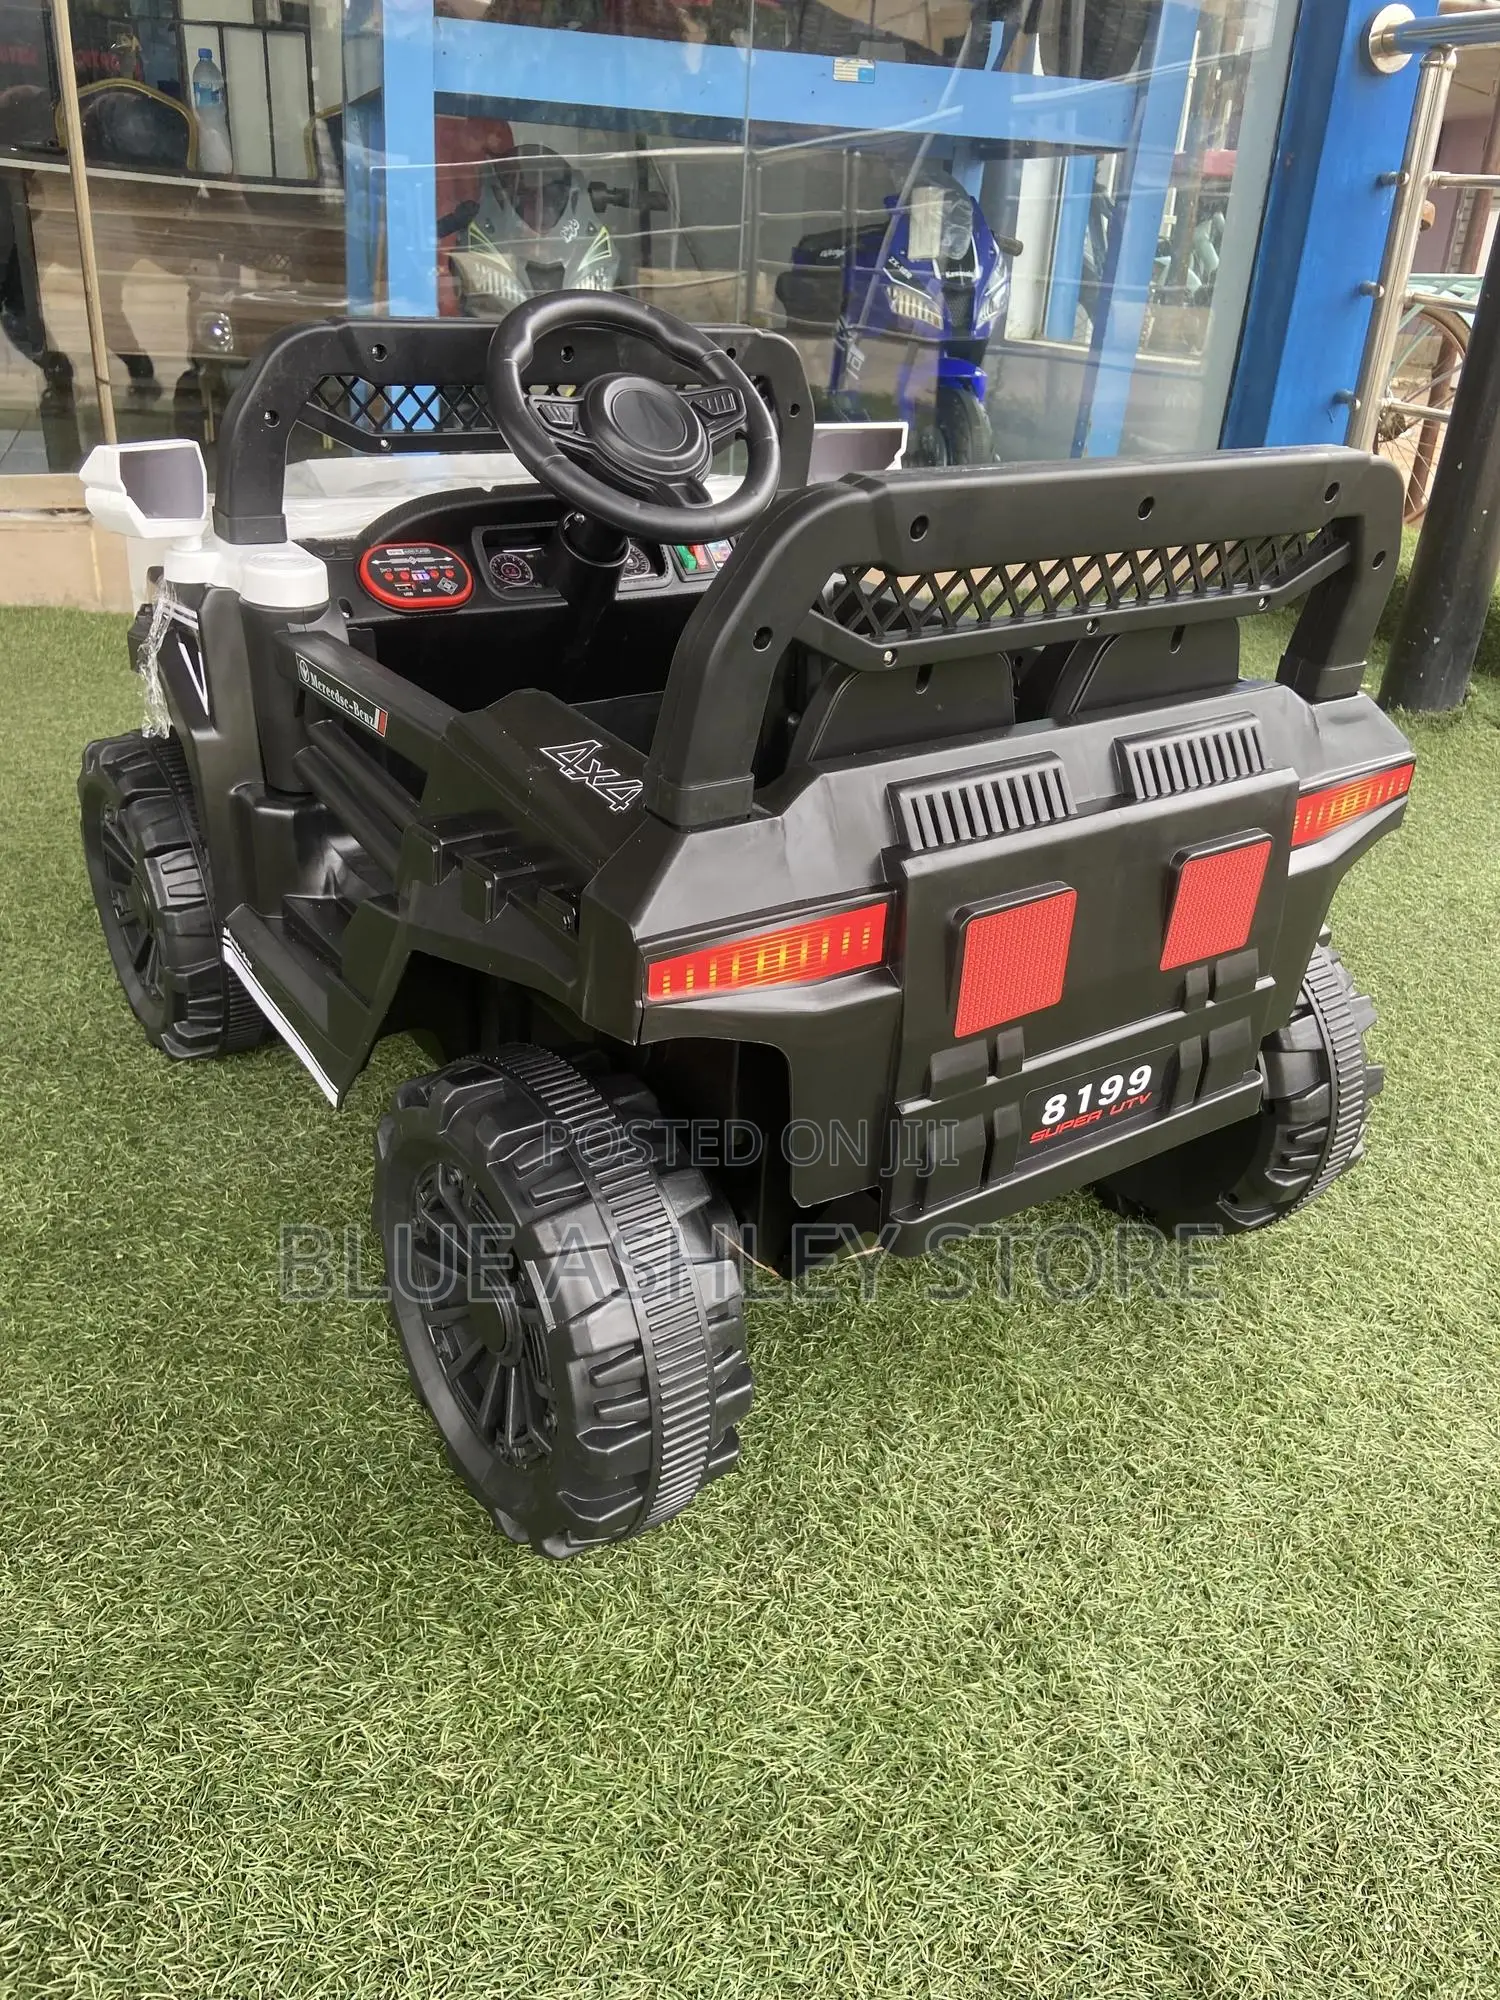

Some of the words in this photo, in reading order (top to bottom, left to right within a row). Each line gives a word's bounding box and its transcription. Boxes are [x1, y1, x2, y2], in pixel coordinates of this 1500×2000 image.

[1029, 1109, 1104, 1145] SUPER
[1109, 1091, 1153, 1117] UTV
[1041, 1064, 1153, 1126] 8199
